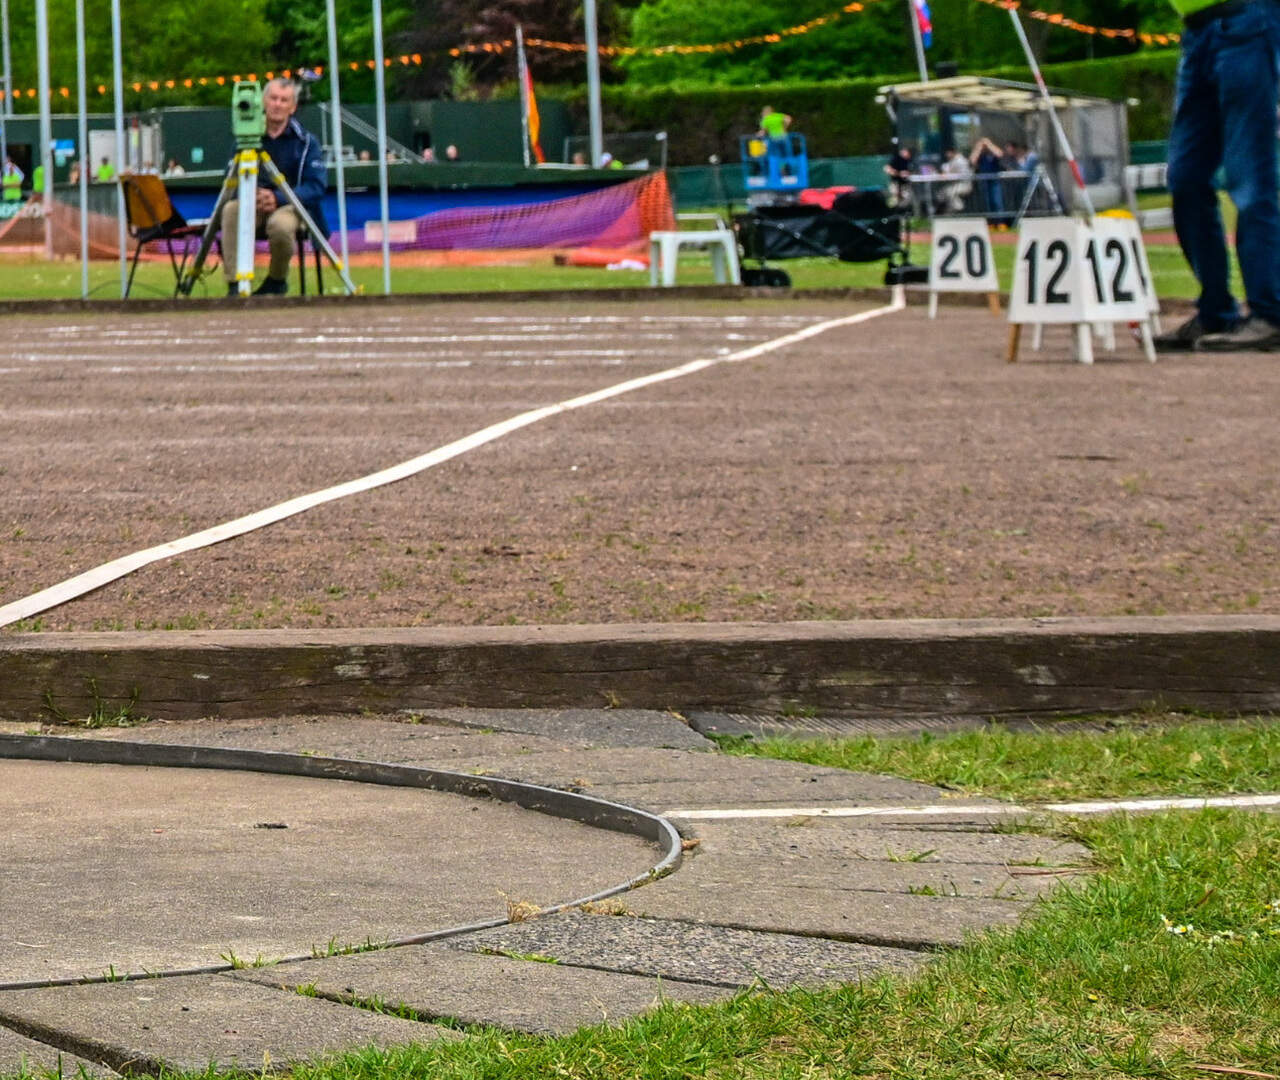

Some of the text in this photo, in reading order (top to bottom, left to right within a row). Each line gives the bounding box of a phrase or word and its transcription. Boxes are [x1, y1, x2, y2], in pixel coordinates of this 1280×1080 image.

[937, 234, 987, 278] 20
[1023, 239, 1070, 304] 12
[1085, 238, 1134, 303] 12
